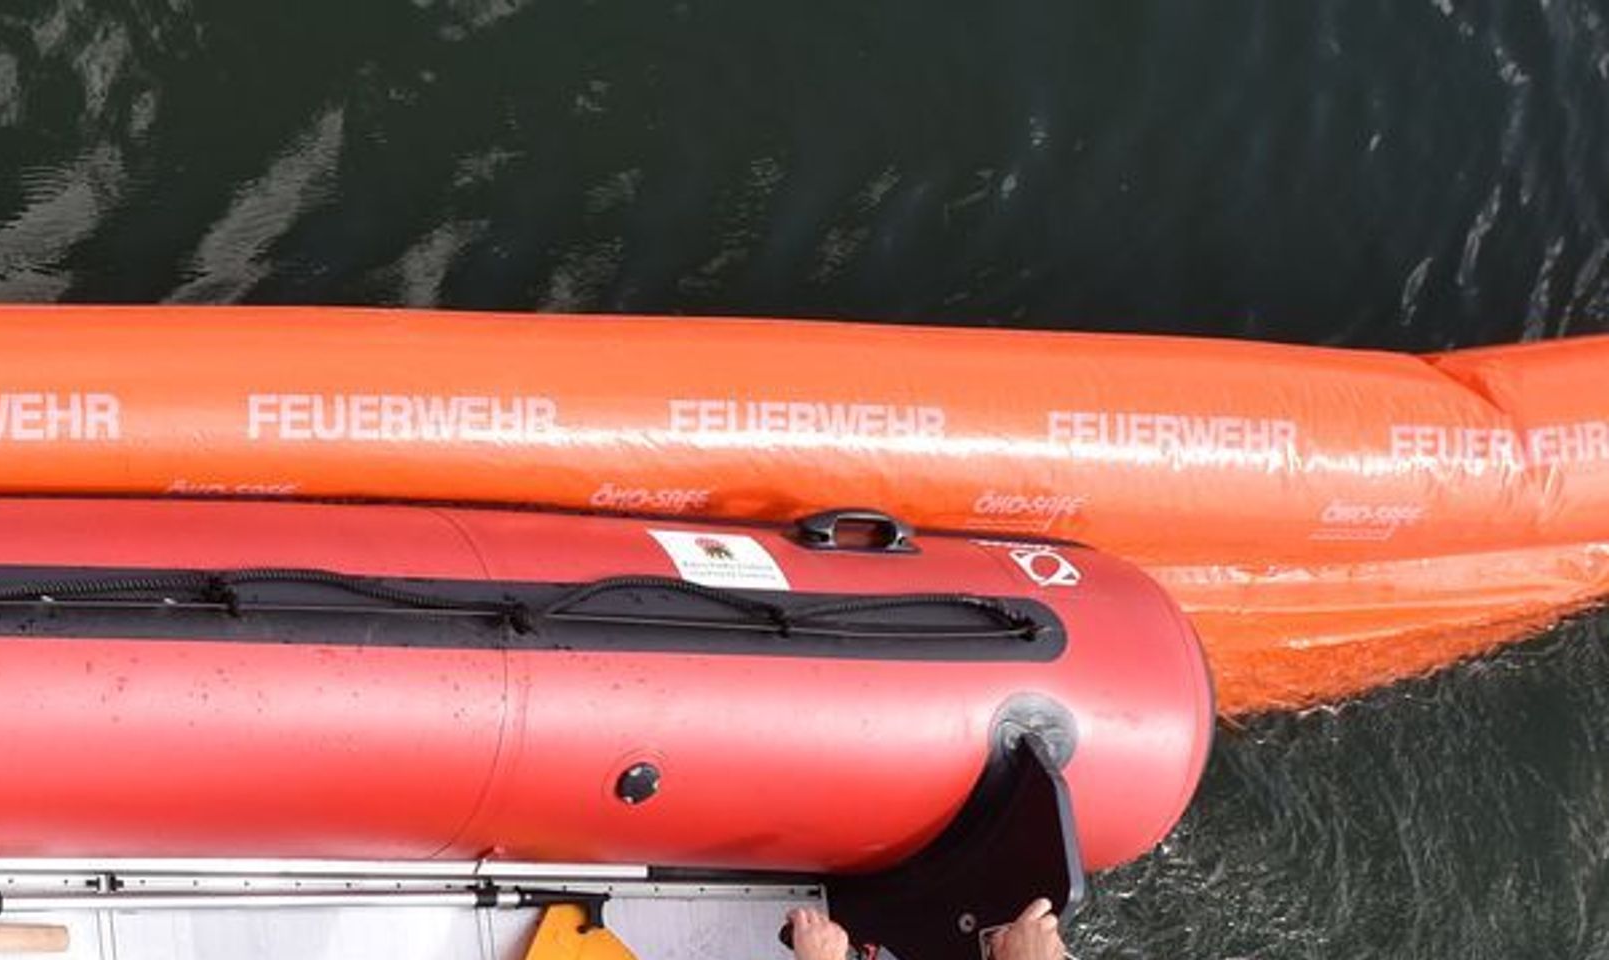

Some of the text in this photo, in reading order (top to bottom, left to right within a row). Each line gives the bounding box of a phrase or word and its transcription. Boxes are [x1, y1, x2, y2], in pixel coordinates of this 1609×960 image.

[247, 393, 558, 440] FEUERWEHR
[667, 398, 947, 441] FEUERWEHR
[1047, 411, 1297, 457] FEUERWEHR
